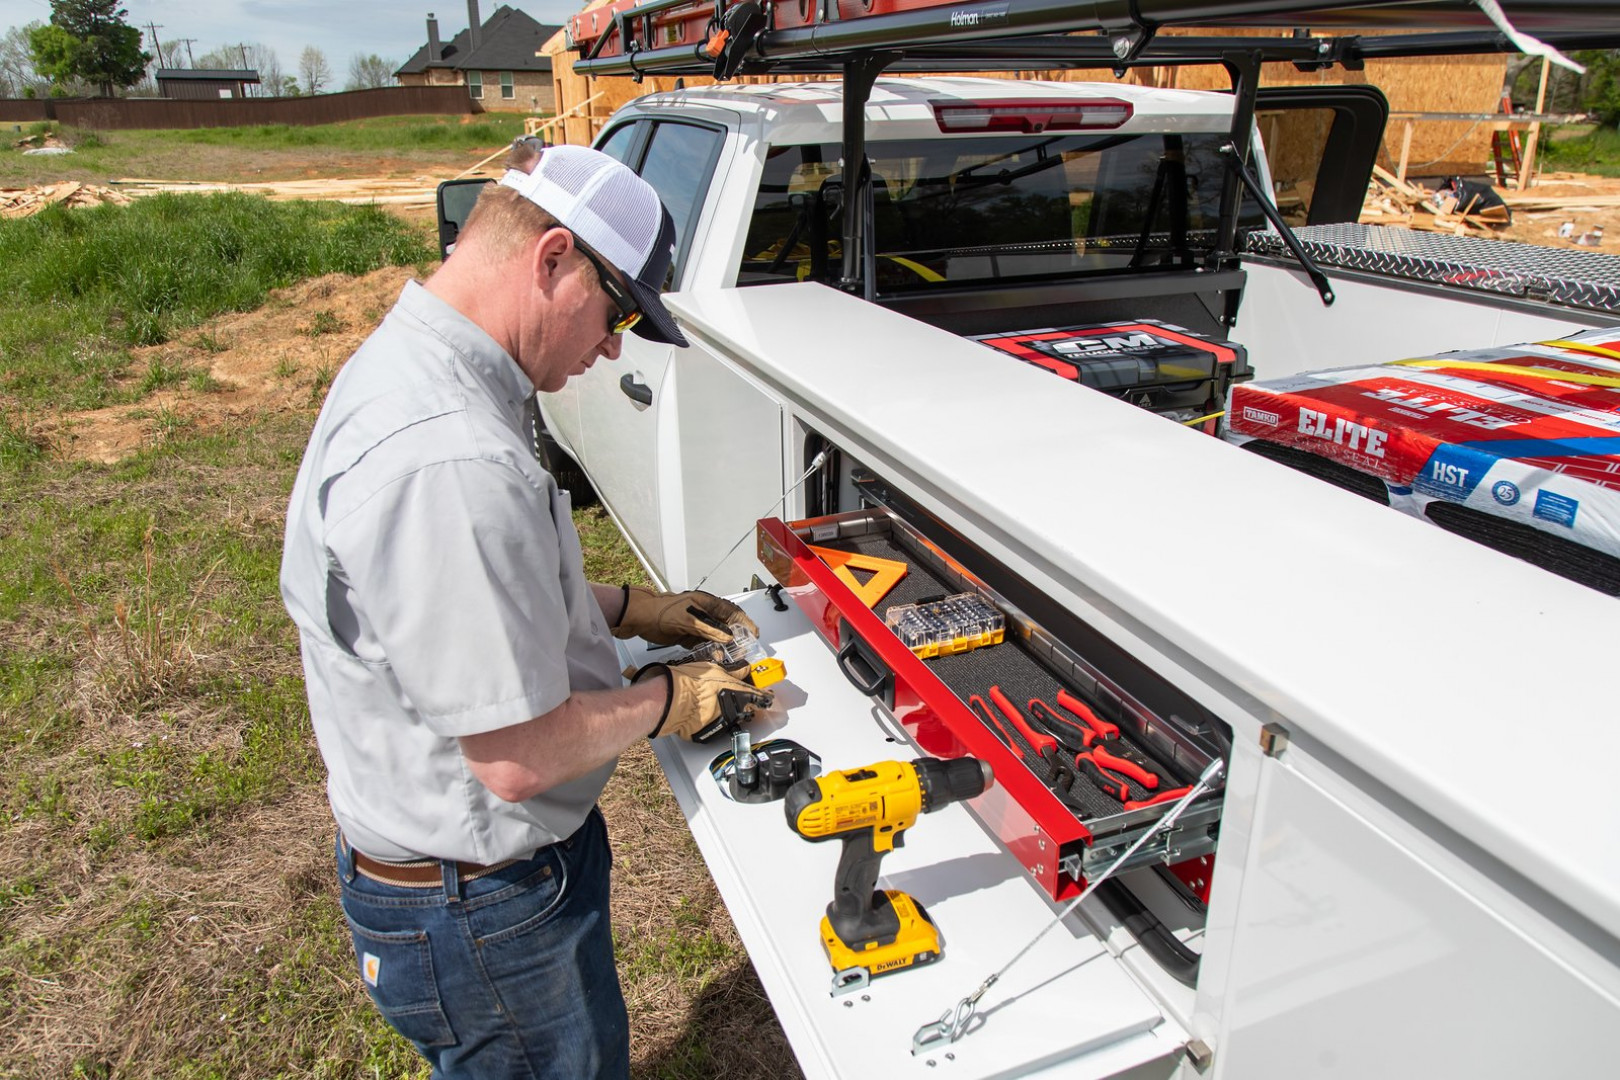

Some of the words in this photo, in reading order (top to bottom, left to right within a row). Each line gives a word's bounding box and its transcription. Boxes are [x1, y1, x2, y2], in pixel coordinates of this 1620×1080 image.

[950, 11, 979, 26] Holman
[1052, 334, 1159, 354] CM
[1245, 409, 1277, 424] TAMKO
[1360, 388, 1519, 430] ELITE
[1297, 407, 1388, 458] ELITE
[1432, 460, 1469, 487] HST
[1499, 486, 1514, 500] 25
